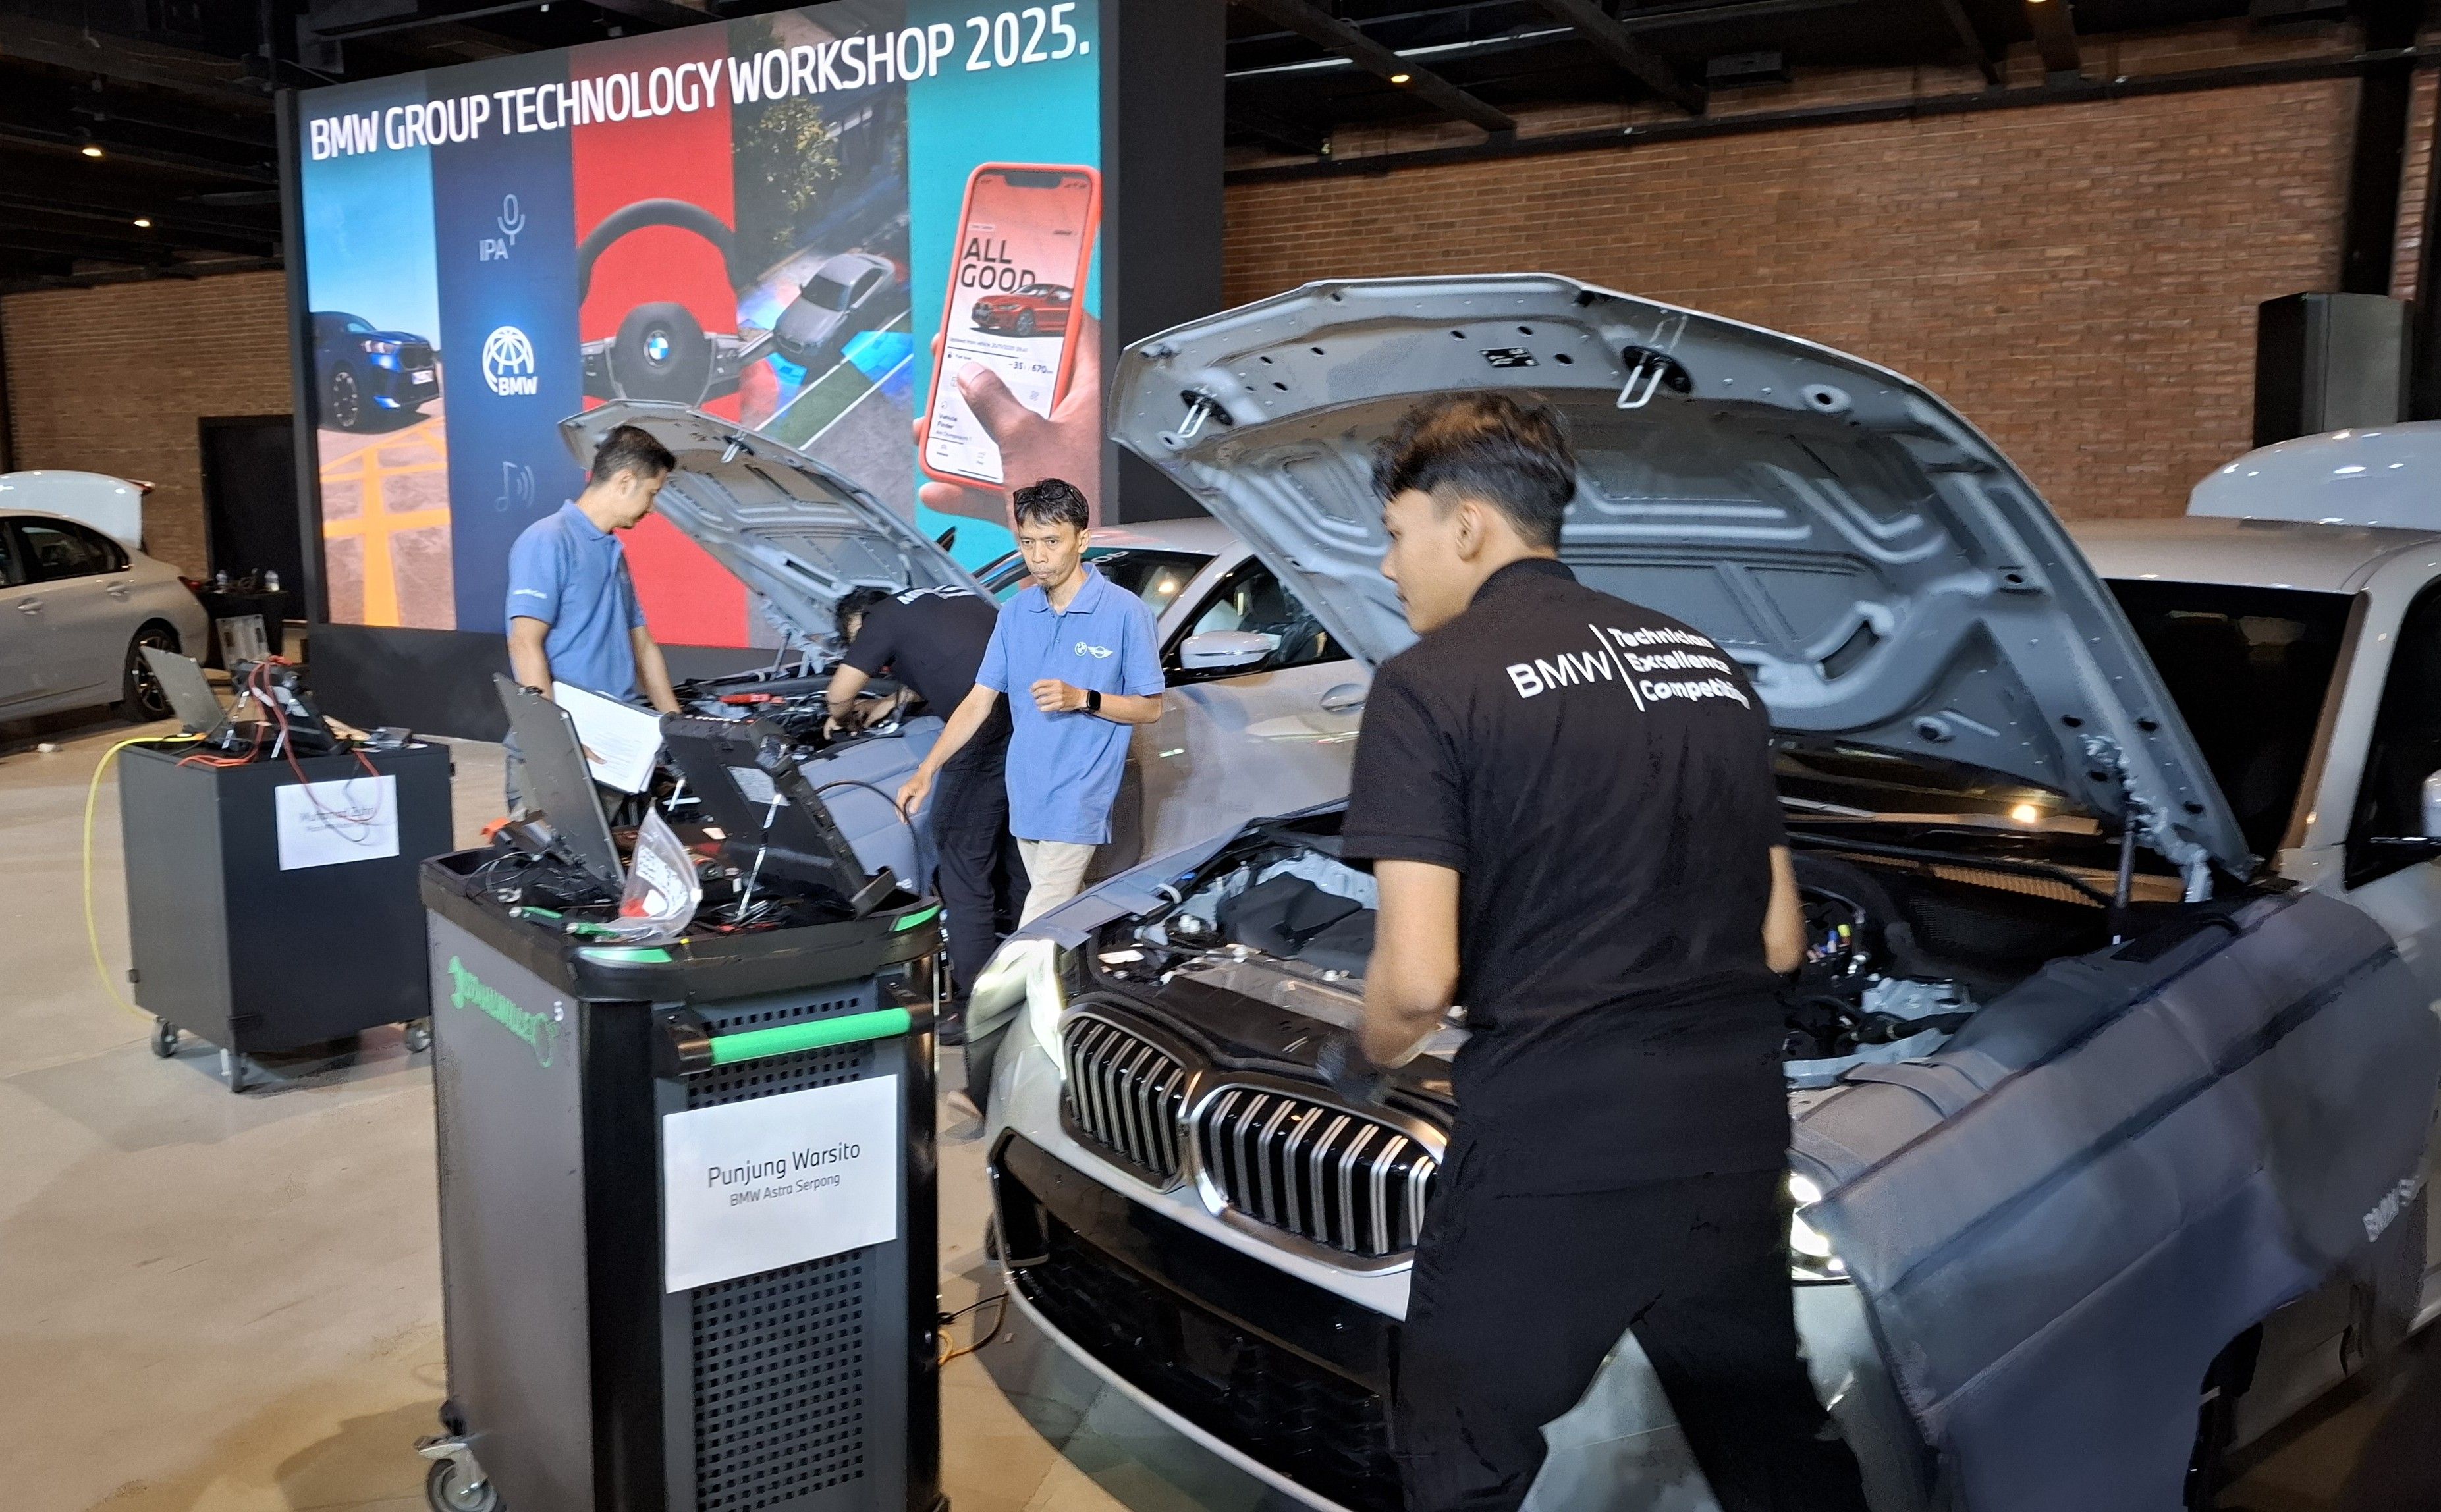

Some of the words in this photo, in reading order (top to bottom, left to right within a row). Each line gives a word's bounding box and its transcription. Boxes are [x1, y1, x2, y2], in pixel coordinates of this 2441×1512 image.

[309, 110, 379, 161] BMW
[384, 94, 489, 151] GROUP
[493, 59, 723, 135] TECHNOLOGY
[728, 23, 954, 105] WORKSHOP
[966, 2, 1090, 72] 2025.
[479, 238, 508, 261] IPA
[963, 237, 1012, 264] ALL
[960, 263, 1036, 292] GOOD
[498, 376, 538, 396] BMW
[1506, 650, 1612, 699] BMW
[1607, 627, 1716, 650] Technician
[1624, 650, 1732, 676] Excellence
[708, 1159, 786, 1188] Punjung
[792, 1141, 860, 1170] Warsito
[730, 1188, 761, 1206] BMW
[763, 1186, 793, 1199] Astra
[796, 1174, 840, 1193] Serpong
